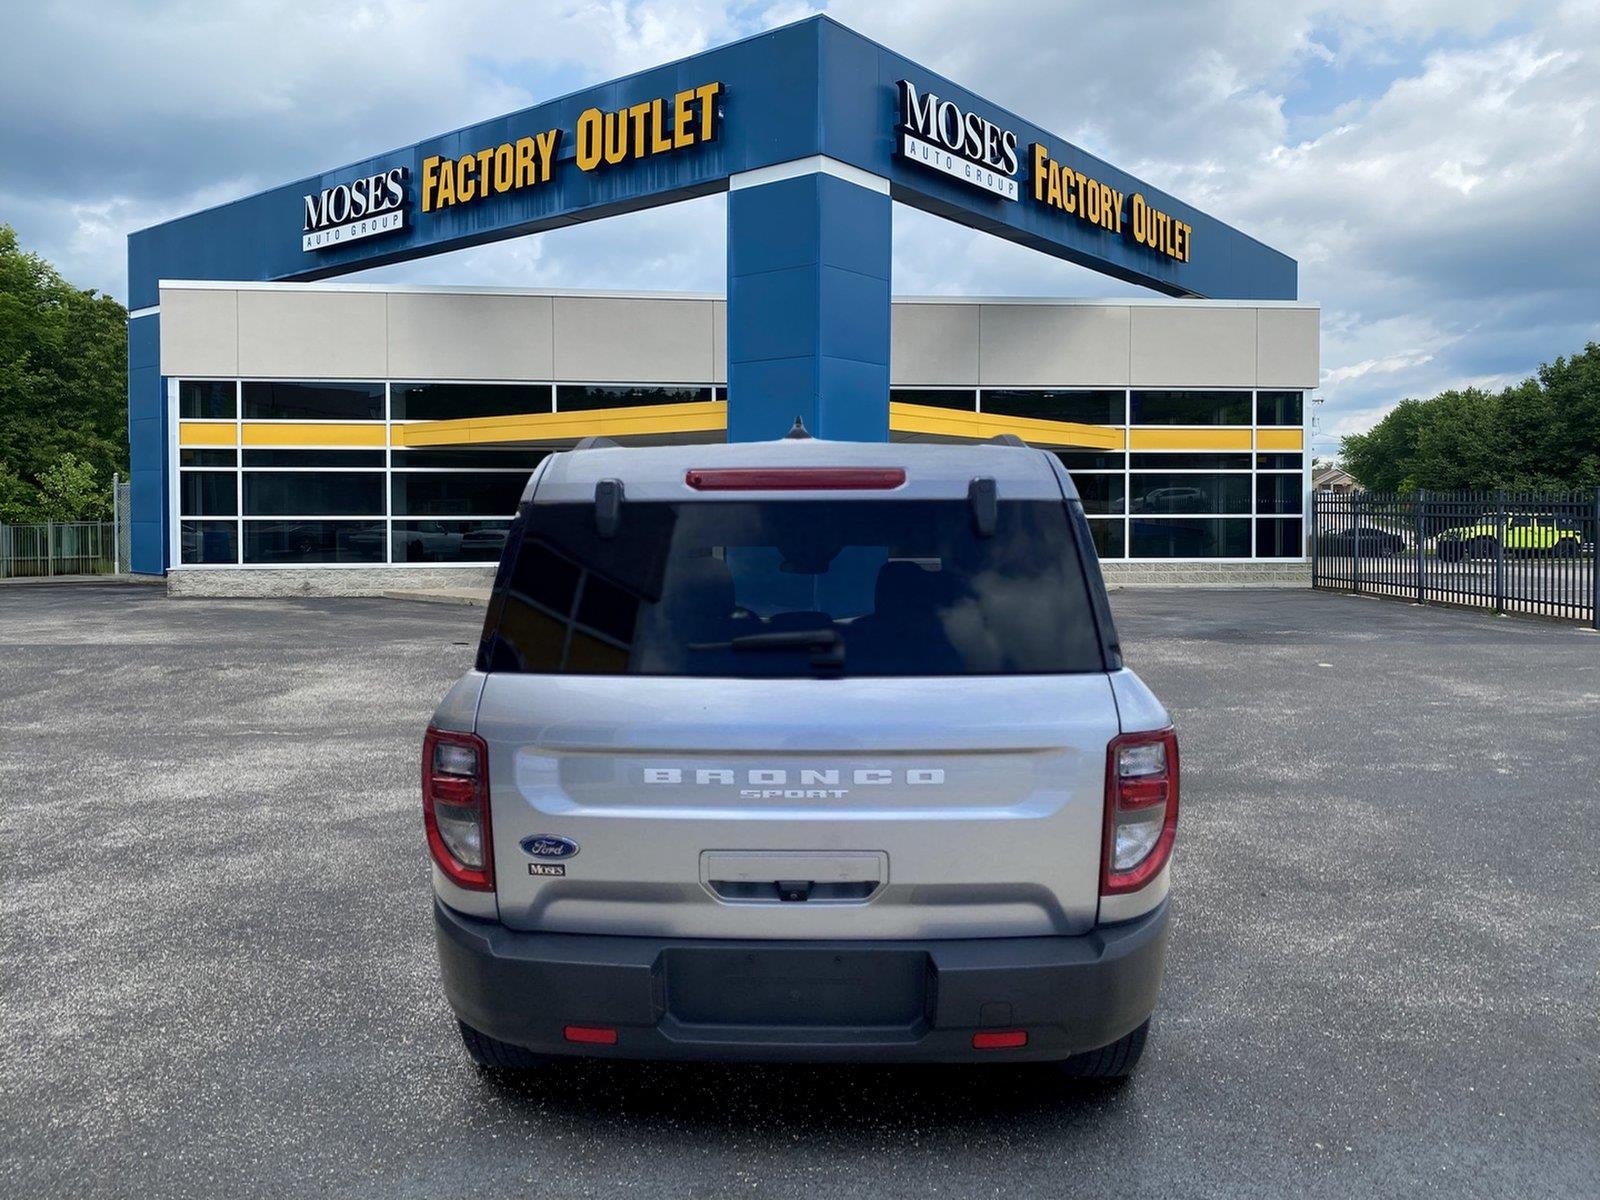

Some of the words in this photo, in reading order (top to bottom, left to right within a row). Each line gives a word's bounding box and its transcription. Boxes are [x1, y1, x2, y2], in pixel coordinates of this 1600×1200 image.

[421, 129, 558, 213] FACTORY
[576, 82, 721, 172] OUTLET
[903, 79, 1018, 176] MOSES
[909, 140, 953, 170] AUTO
[964, 163, 1015, 196] GROUP
[303, 168, 403, 231] MOSES
[1034, 142, 1124, 234] FACTORY
[1132, 192, 1192, 263] OUTLET
[306, 227, 341, 248] AUTO
[350, 213, 399, 237] GROUP
[643, 768, 946, 785] BRONCO
[740, 789, 849, 799] SPORT
[531, 840, 565, 855] Ford
